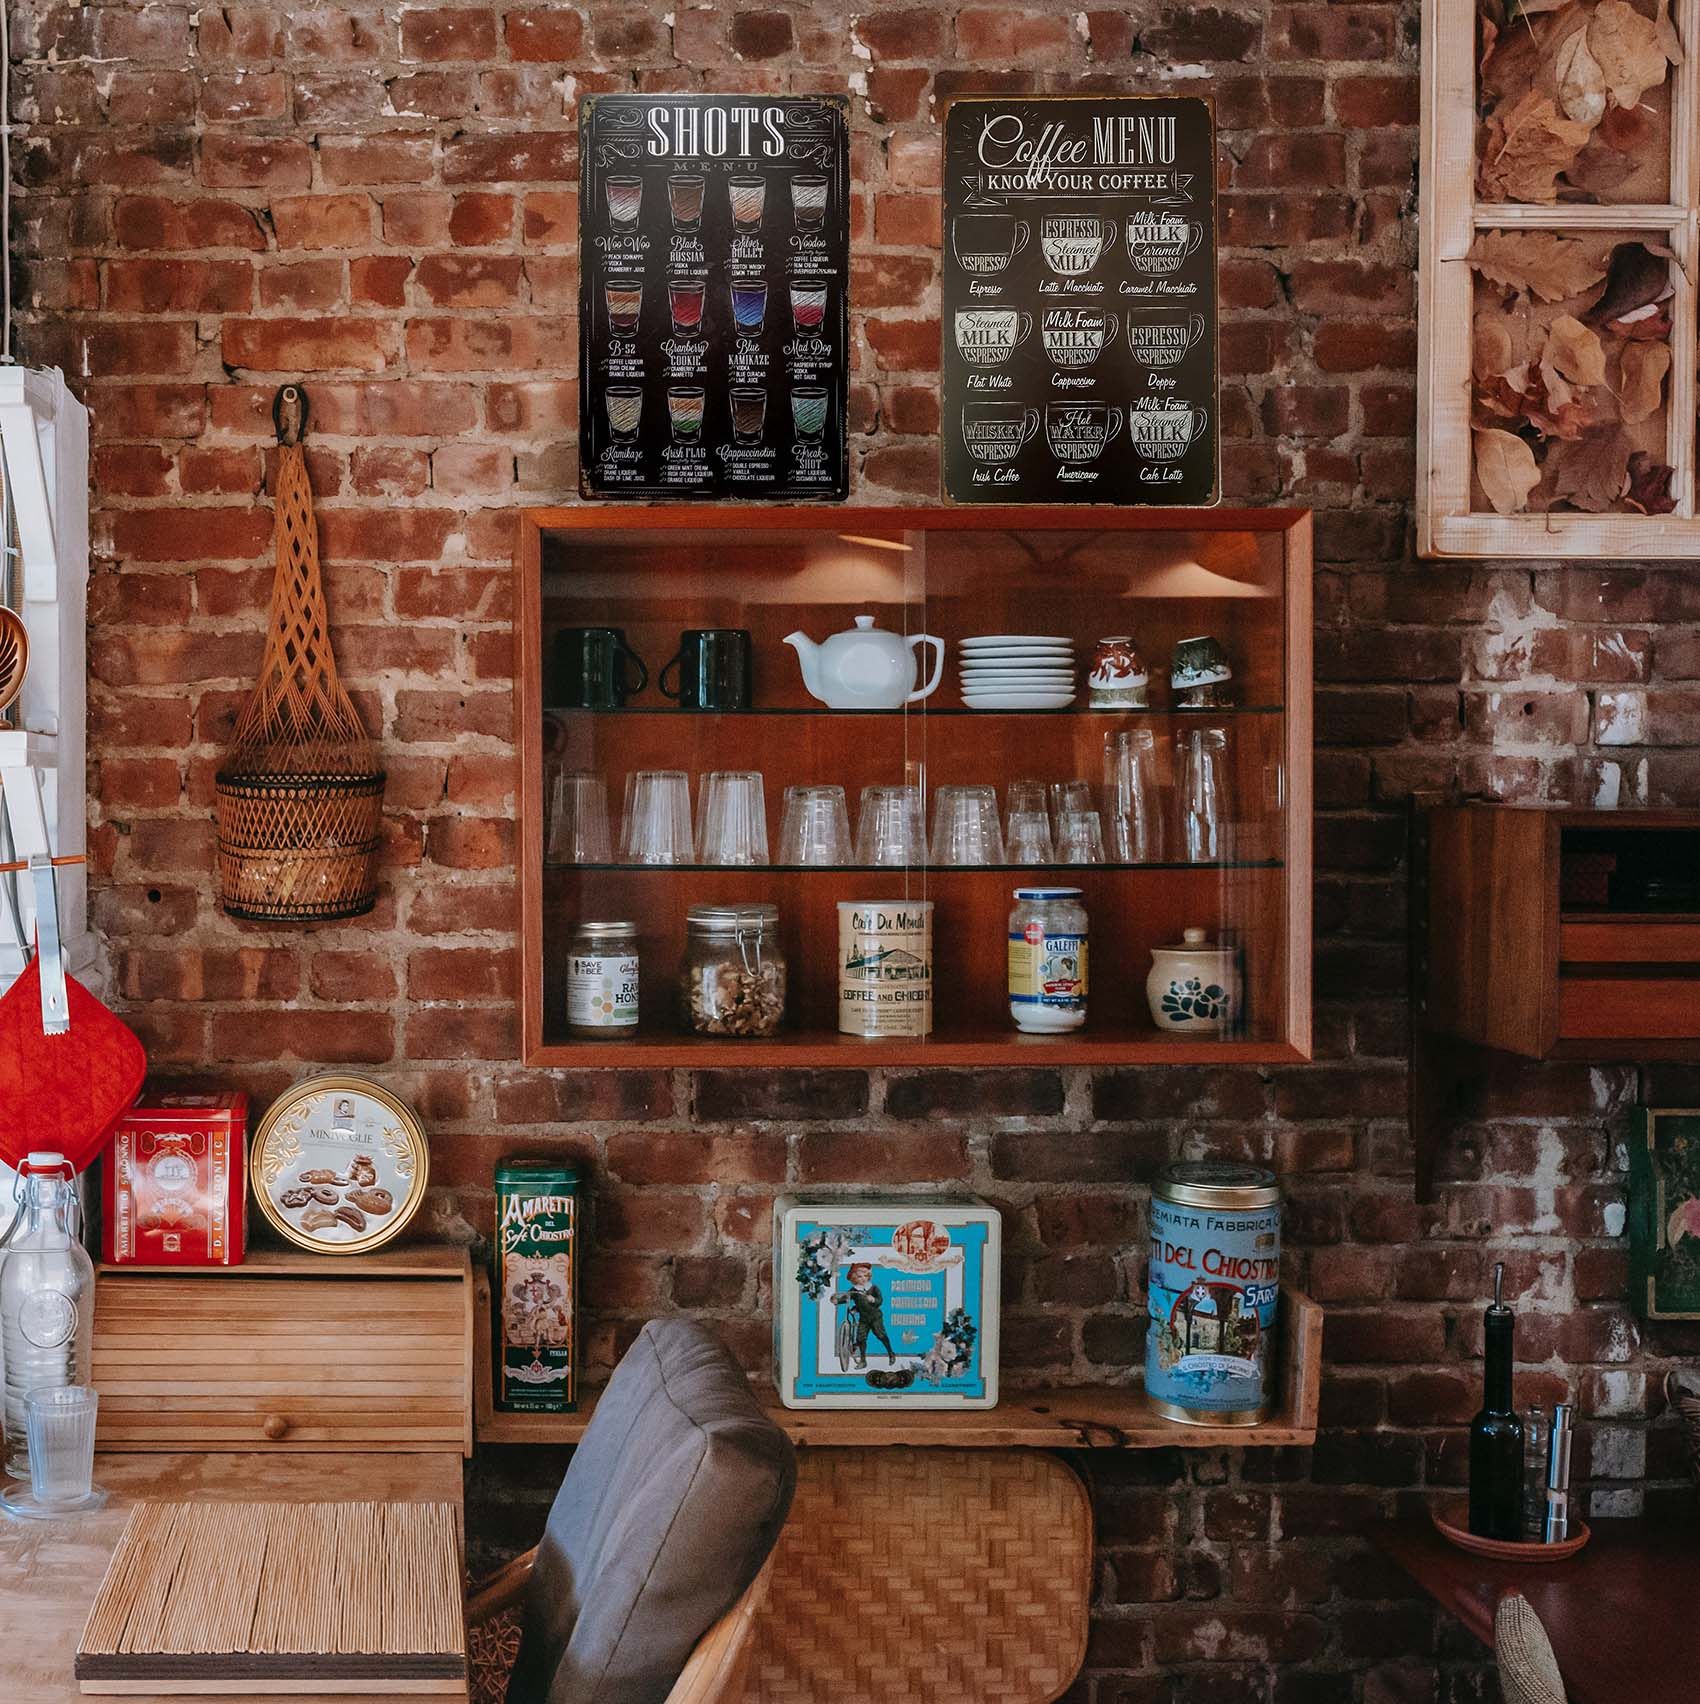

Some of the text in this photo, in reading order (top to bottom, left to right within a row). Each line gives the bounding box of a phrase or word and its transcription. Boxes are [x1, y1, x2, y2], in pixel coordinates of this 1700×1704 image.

[647, 107, 785, 157] SHOTS
[978, 113, 1176, 184] Coffee MENU
[987, 172, 1167, 190] KNOW YOUR COFFEE
[1132, 211, 1184, 225] Milk Foam
[1045, 220, 1100, 238] ESPRESSO
[1134, 226, 1182, 241] MILK
[594, 235, 651, 252] Woo Woo
[671, 235, 703, 252] Black
[789, 234, 826, 250] Voodoo
[1046, 239, 1100, 256] Steamed
[1130, 241, 1184, 258] Caramel
[670, 251, 705, 262] RUSSIAN
[961, 256, 1007, 272] ESPRESSO
[1050, 254, 1094, 271] MILK
[1135, 256, 1180, 273] ESPRESSO
[969, 280, 1003, 298] Espresso
[1039, 280, 1105, 293] Latte Macchiato
[1119, 280, 1198, 294] Caramel Macchiato
[959, 313, 1015, 330] Steamed
[1045, 311, 1103, 328] Milk Foam
[962, 330, 1012, 345] MILK
[1049, 332, 1098, 347] MILK
[1131, 327, 1187, 345] ESPRESSO
[660, 339, 709, 357] Cranberry
[736, 338, 760, 355] Blue
[783, 338, 832, 357] Mad Dog
[670, 355, 701, 366] COOKIE
[728, 354, 769, 365] KAMIKAZE
[963, 348, 1010, 364] ESPRESSO
[1051, 348, 1096, 365] ESPRESSO
[1136, 348, 1182, 365] ESPRESSO
[966, 375, 1013, 388] Flat White
[1051, 372, 1096, 390] Cappuccino
[1147, 373, 1177, 390] Doppio
[1136, 397, 1188, 411] Milk Foam
[1058, 410, 1092, 428] Hot
[1135, 412, 1188, 428] Steamed
[965, 423, 1025, 440] WHISKEY
[1049, 425, 1104, 440] WATER
[1136, 427, 1186, 441] MILK
[600, 445, 644, 462] Kamikaze
[662, 445, 706, 461] Irish FLAG
[971, 444, 1017, 460] ESPRESSO
[1054, 443, 1100, 460] ESPRESSO
[1139, 443, 1185, 460] ESPRESSO
[799, 459, 822, 470] SHOT
[1056, 465, 1099, 480] Americano
[972, 468, 1020, 482] Irish Coffee
[1139, 467, 1184, 481] Cafe Latte
[877, 913, 892, 930] Du
[843, 989, 874, 1001] COFFEE
[499, 1194, 574, 1230] AMARETTI
[1206, 1216, 1271, 1232] FABBRICA
[501, 1224, 531, 1254] Soft
[1165, 1242, 1197, 1270] DEL
